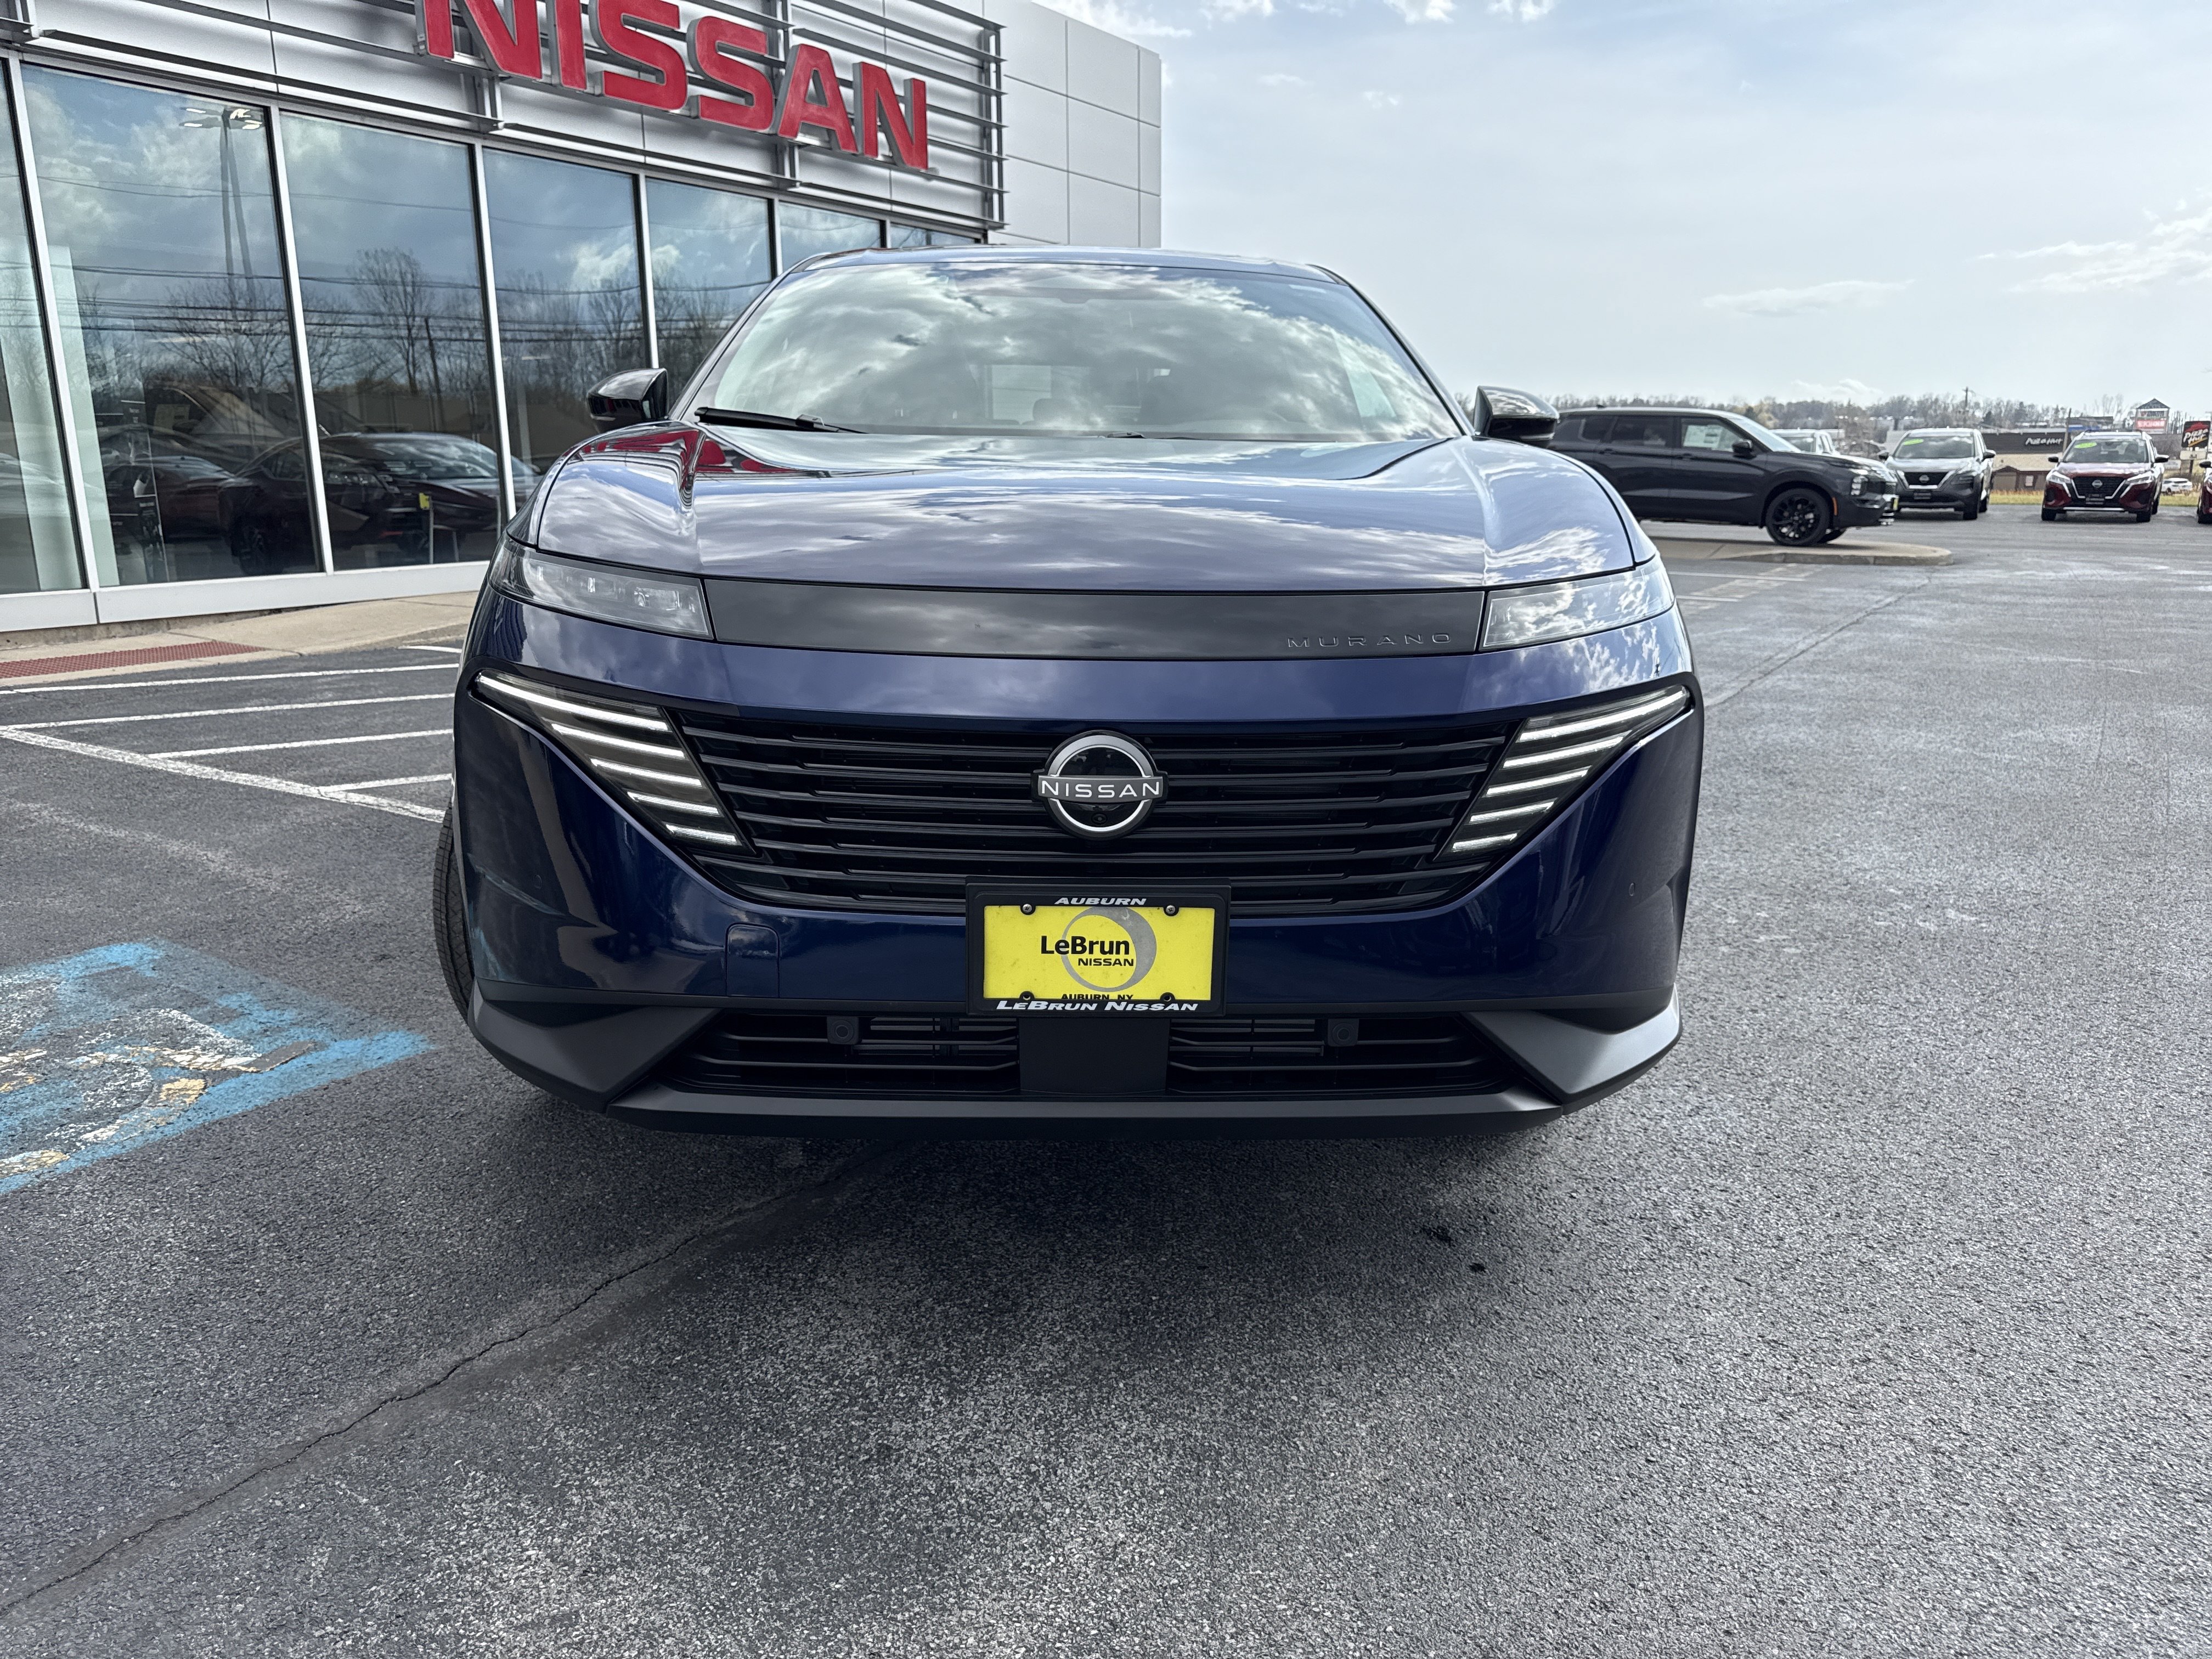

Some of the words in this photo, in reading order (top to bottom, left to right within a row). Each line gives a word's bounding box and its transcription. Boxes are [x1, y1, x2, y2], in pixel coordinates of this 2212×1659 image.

[420, 0, 929, 171] NISSAN
[2183, 428, 2208, 443] Pizza
[1288, 633, 1452, 647] MURANO
[1041, 780, 1159, 798] NISSAN
[1054, 897, 1147, 906] AUBURN
[1041, 935, 1130, 956] LeBrun
[1077, 958, 1135, 967] NISSAN
